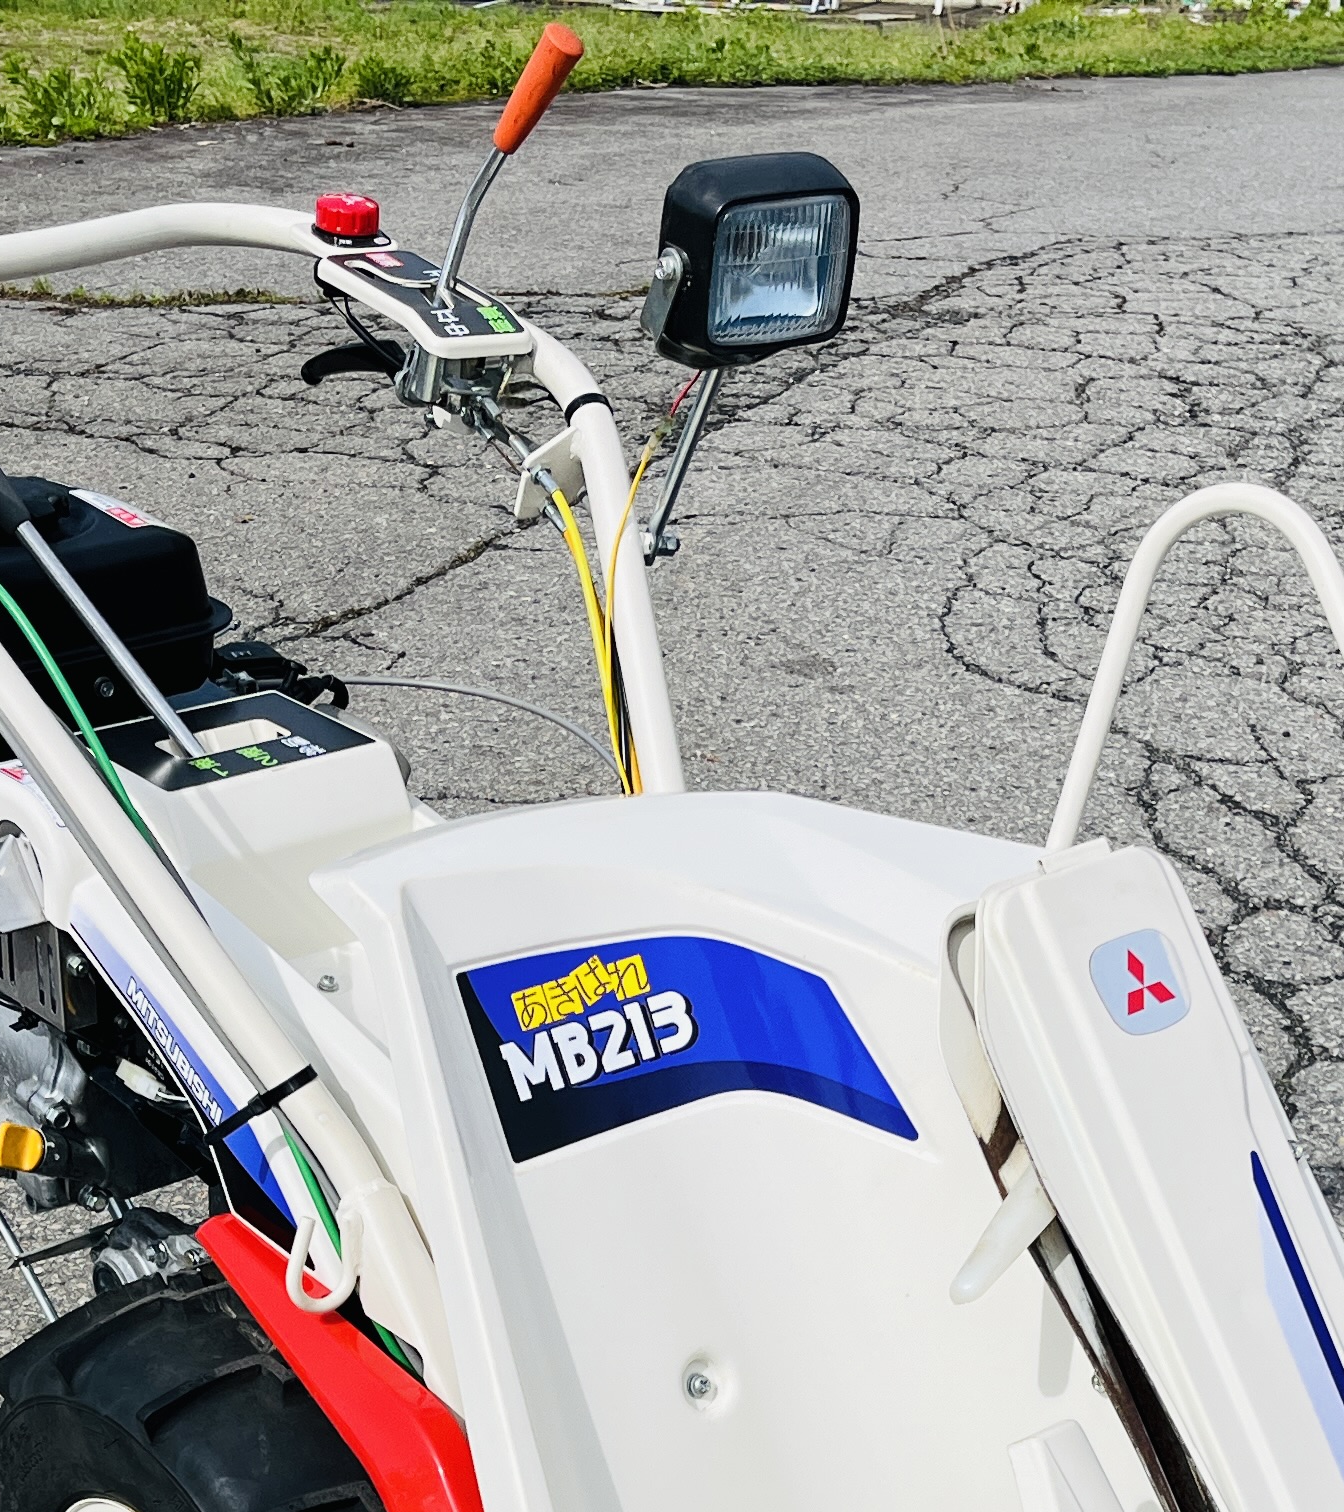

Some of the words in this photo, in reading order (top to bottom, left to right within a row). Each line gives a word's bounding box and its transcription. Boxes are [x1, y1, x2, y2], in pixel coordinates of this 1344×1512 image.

[430, 308, 470, 336] 中立
[126, 975, 224, 1127] MITSUBISHI
[499, 990, 696, 1102] MB213
